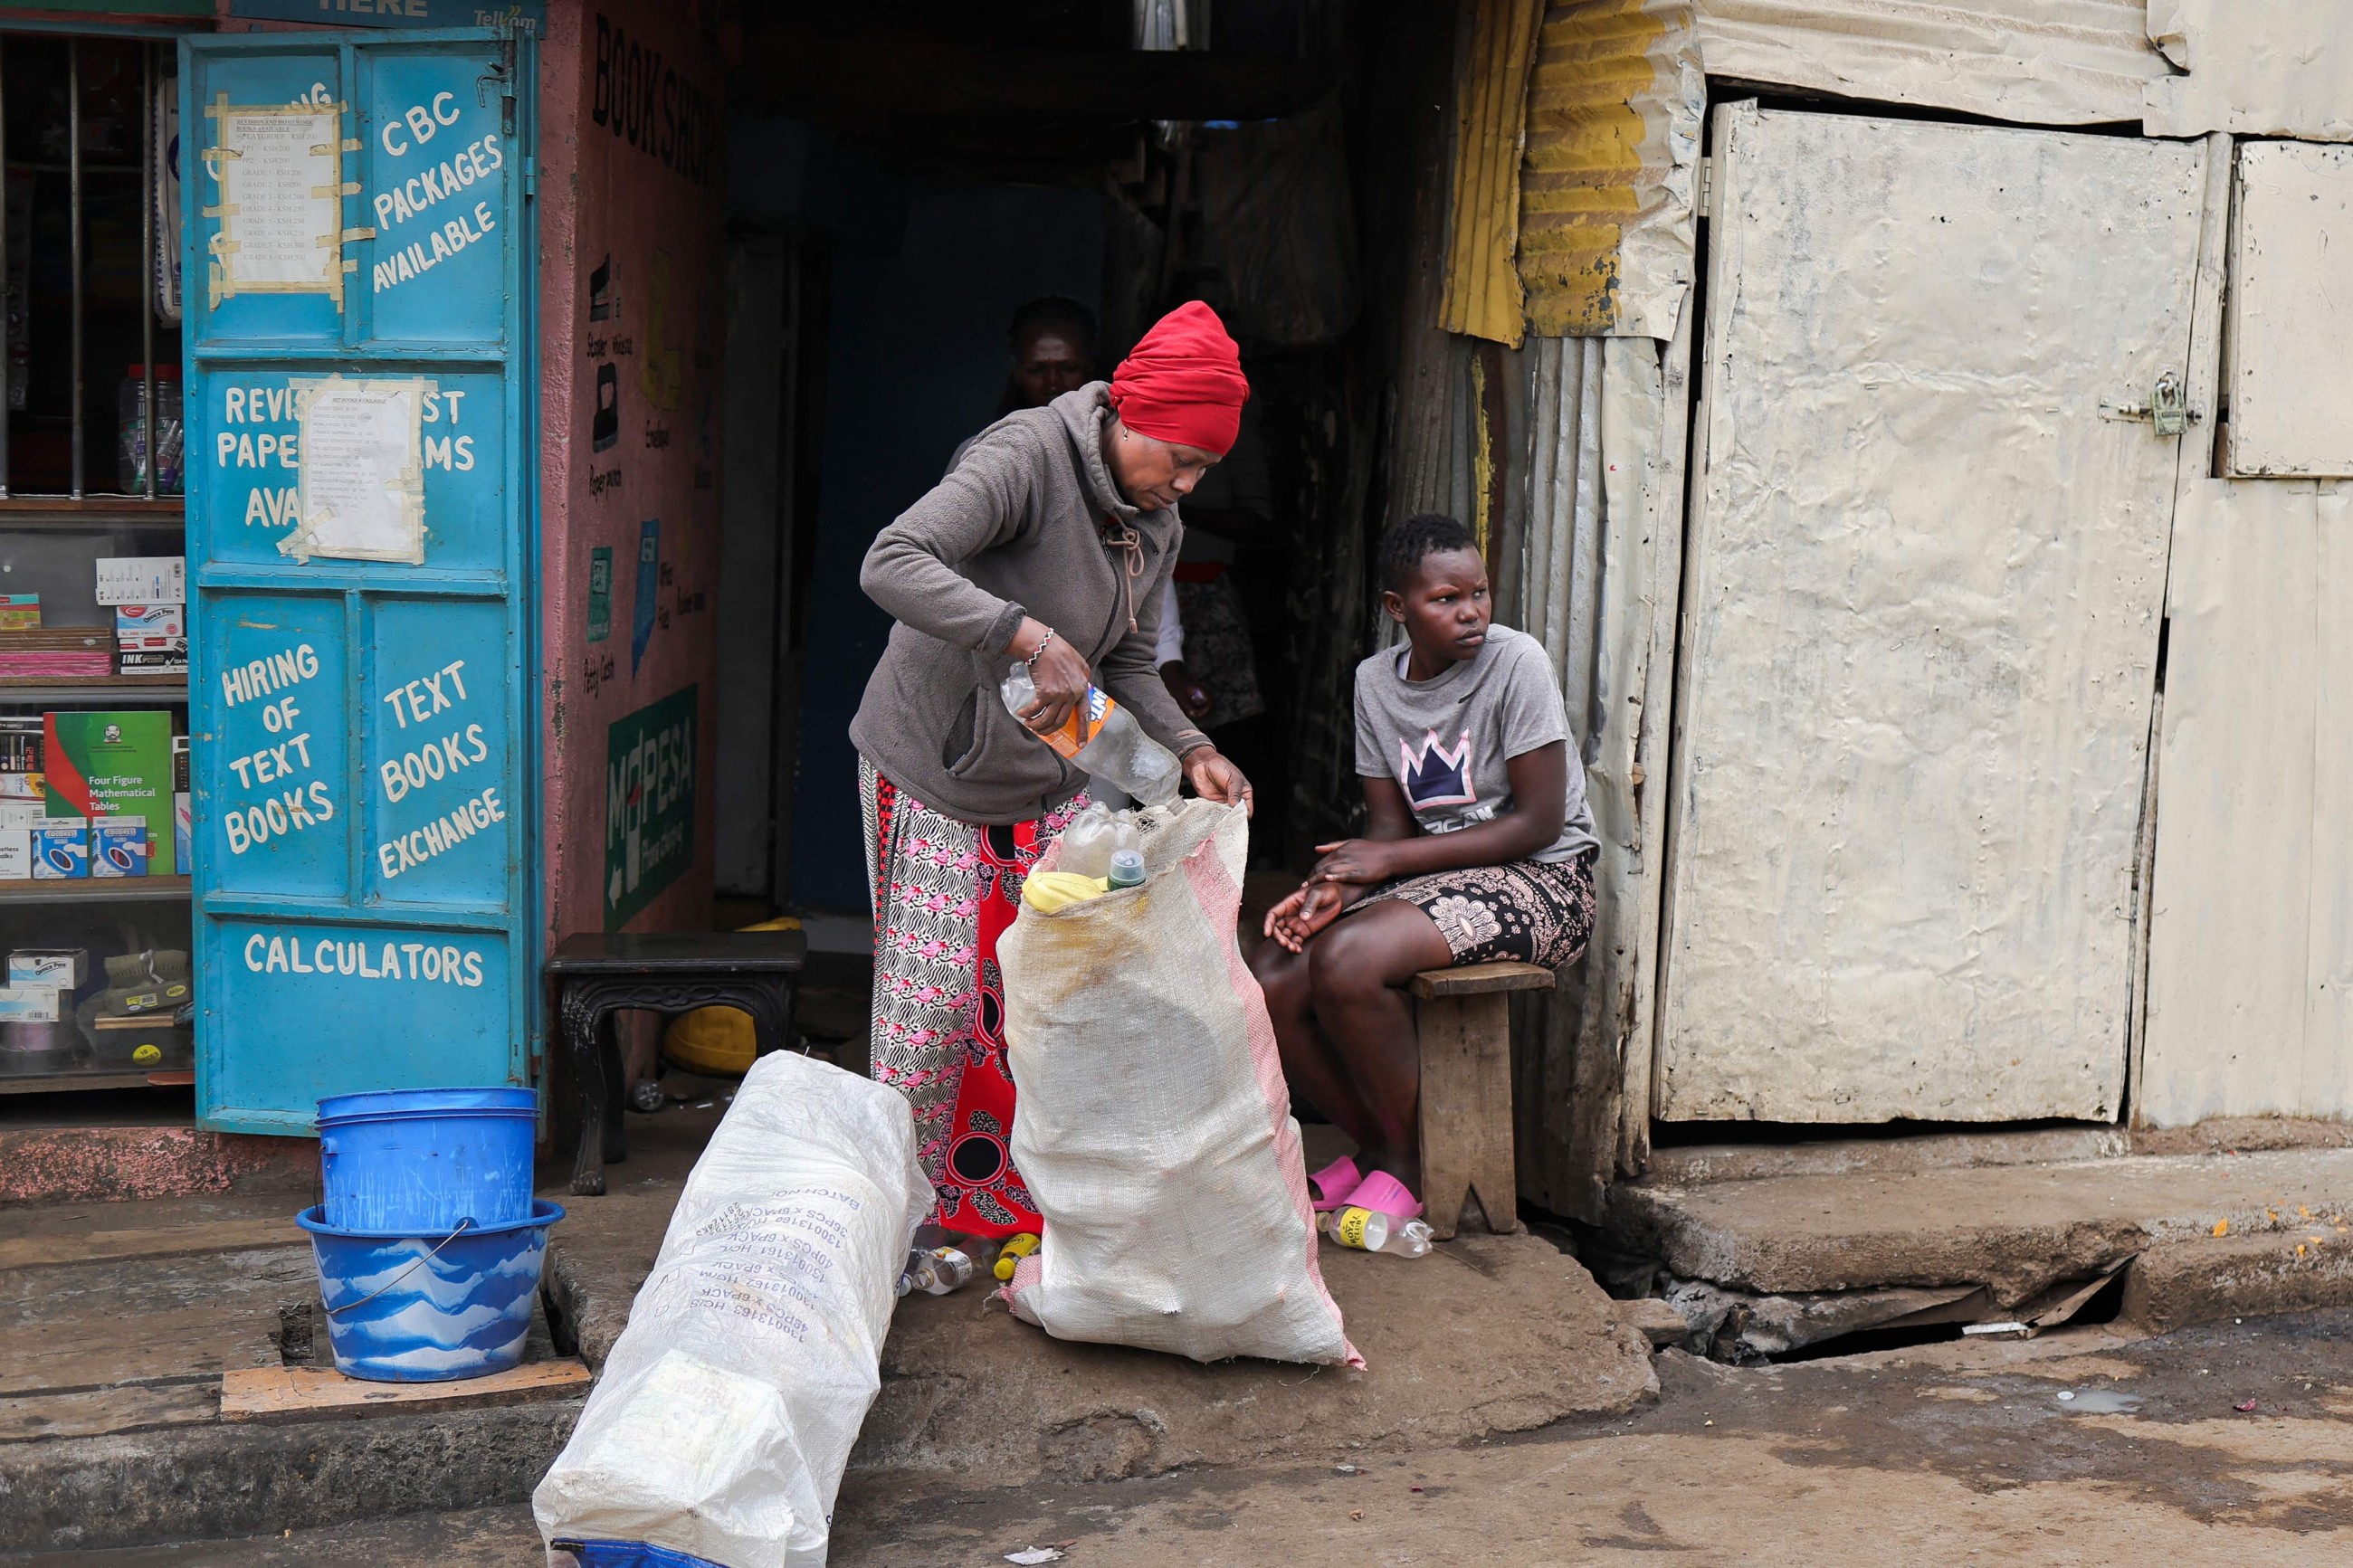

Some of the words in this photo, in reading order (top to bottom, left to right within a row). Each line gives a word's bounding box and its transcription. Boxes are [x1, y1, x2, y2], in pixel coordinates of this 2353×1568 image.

[473, 6, 536, 30] Telkom
[382, 91, 460, 157] CBC
[373, 134, 502, 231] PACKAGES
[373, 201, 496, 293] AVAILABLE
[122, 654, 143, 664] INK
[222, 643, 319, 707] HIRING
[384, 660, 467, 728] TEXT
[262, 696, 300, 733] OF
[229, 732, 310, 789] TEXT
[380, 724, 488, 803] BOOKS
[89, 776, 110, 785] Four
[113, 775, 143, 786] Figure
[89, 788, 156, 798] Mathematical
[90, 802, 119, 811] Tables
[224, 781, 334, 855] BOOKS
[379, 787, 505, 879] EXCHANGE
[244, 933, 483, 987] CALCULATORS
[770, 1188, 801, 1199] NO:
[805, 1188, 862, 1211] BATCH
[726, 1231, 777, 1243] 6PACK
[774, 1216, 841, 1250] 130013160
[805, 1209, 848, 1238] 36PCS
[1348, 1215, 1360, 1244] ROYAL
[1354, 1220, 1362, 1240] CLUB
[710, 1260, 763, 1274] 6PACK
[759, 1246, 826, 1284] 130013161
[793, 1238, 834, 1270] 40PCS
[690, 1298, 726, 1310] HC/S
[699, 1288, 751, 1305] 6PACK
[732, 1304, 804, 1344] 130013163
[766, 1303, 809, 1333] 48PCS
